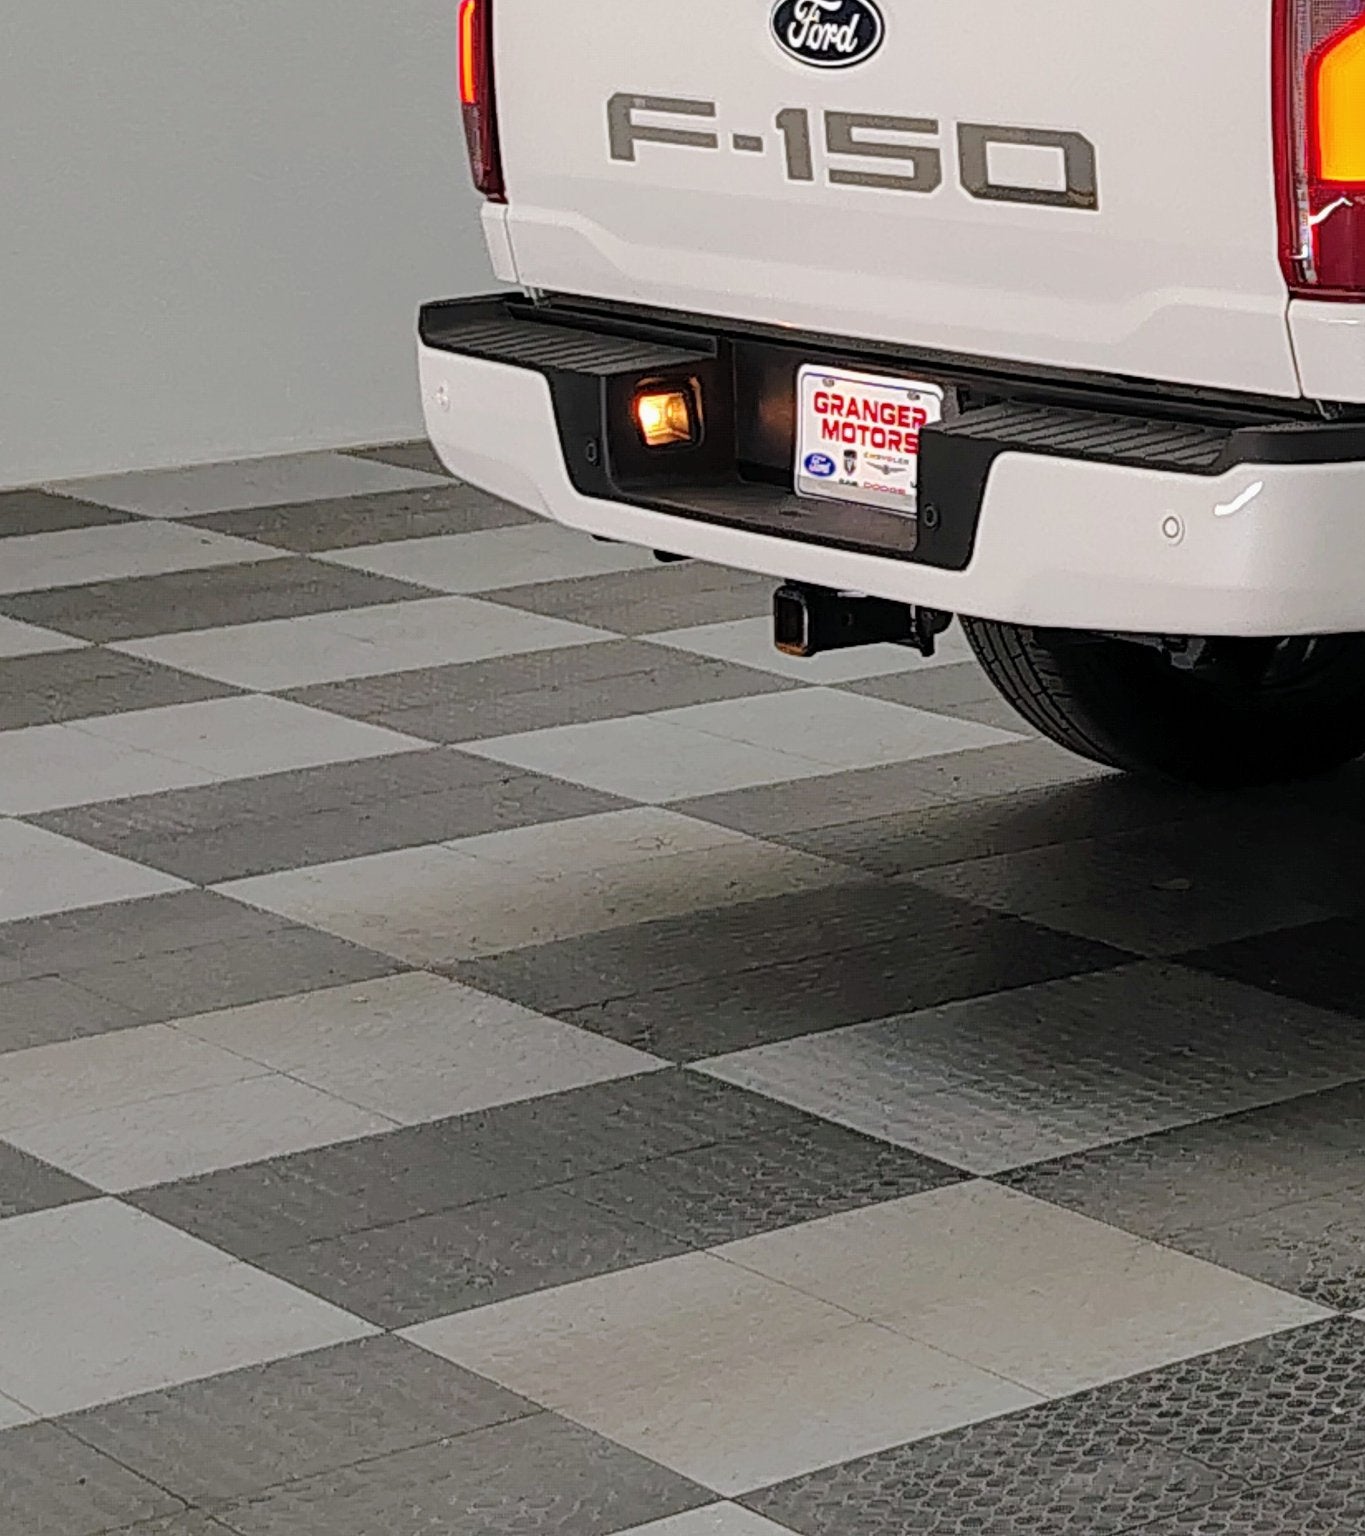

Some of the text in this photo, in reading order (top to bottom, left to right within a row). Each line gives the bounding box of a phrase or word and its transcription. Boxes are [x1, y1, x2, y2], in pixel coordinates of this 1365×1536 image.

[606, 92, 1100, 211] F-150
[813, 390, 928, 430] GRANGER
[821, 418, 919, 454] MOTORS
